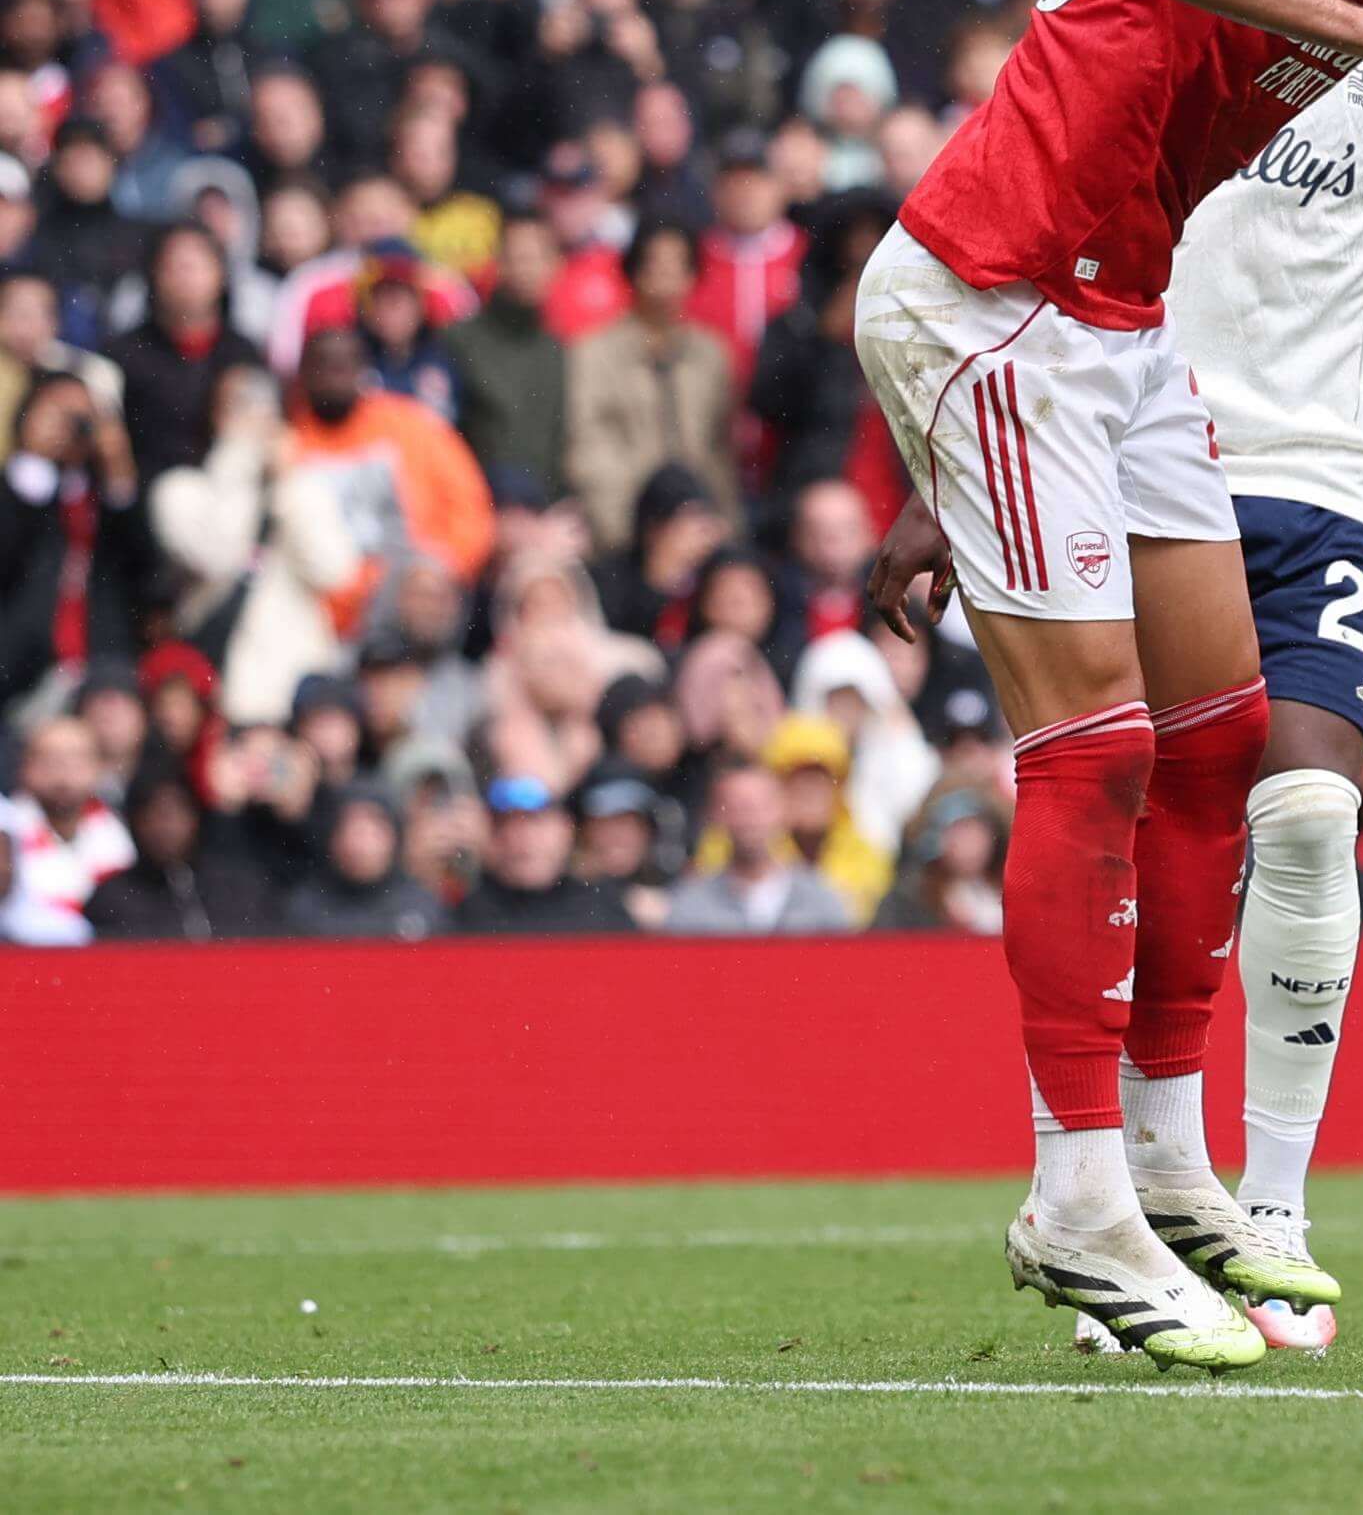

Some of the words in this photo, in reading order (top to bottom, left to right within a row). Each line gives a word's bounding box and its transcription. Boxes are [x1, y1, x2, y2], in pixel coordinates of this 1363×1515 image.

[1275, 66, 1337, 109] BETT
[1237, 127, 1356, 207] lly's
[1072, 542, 1105, 551] Arsenal
